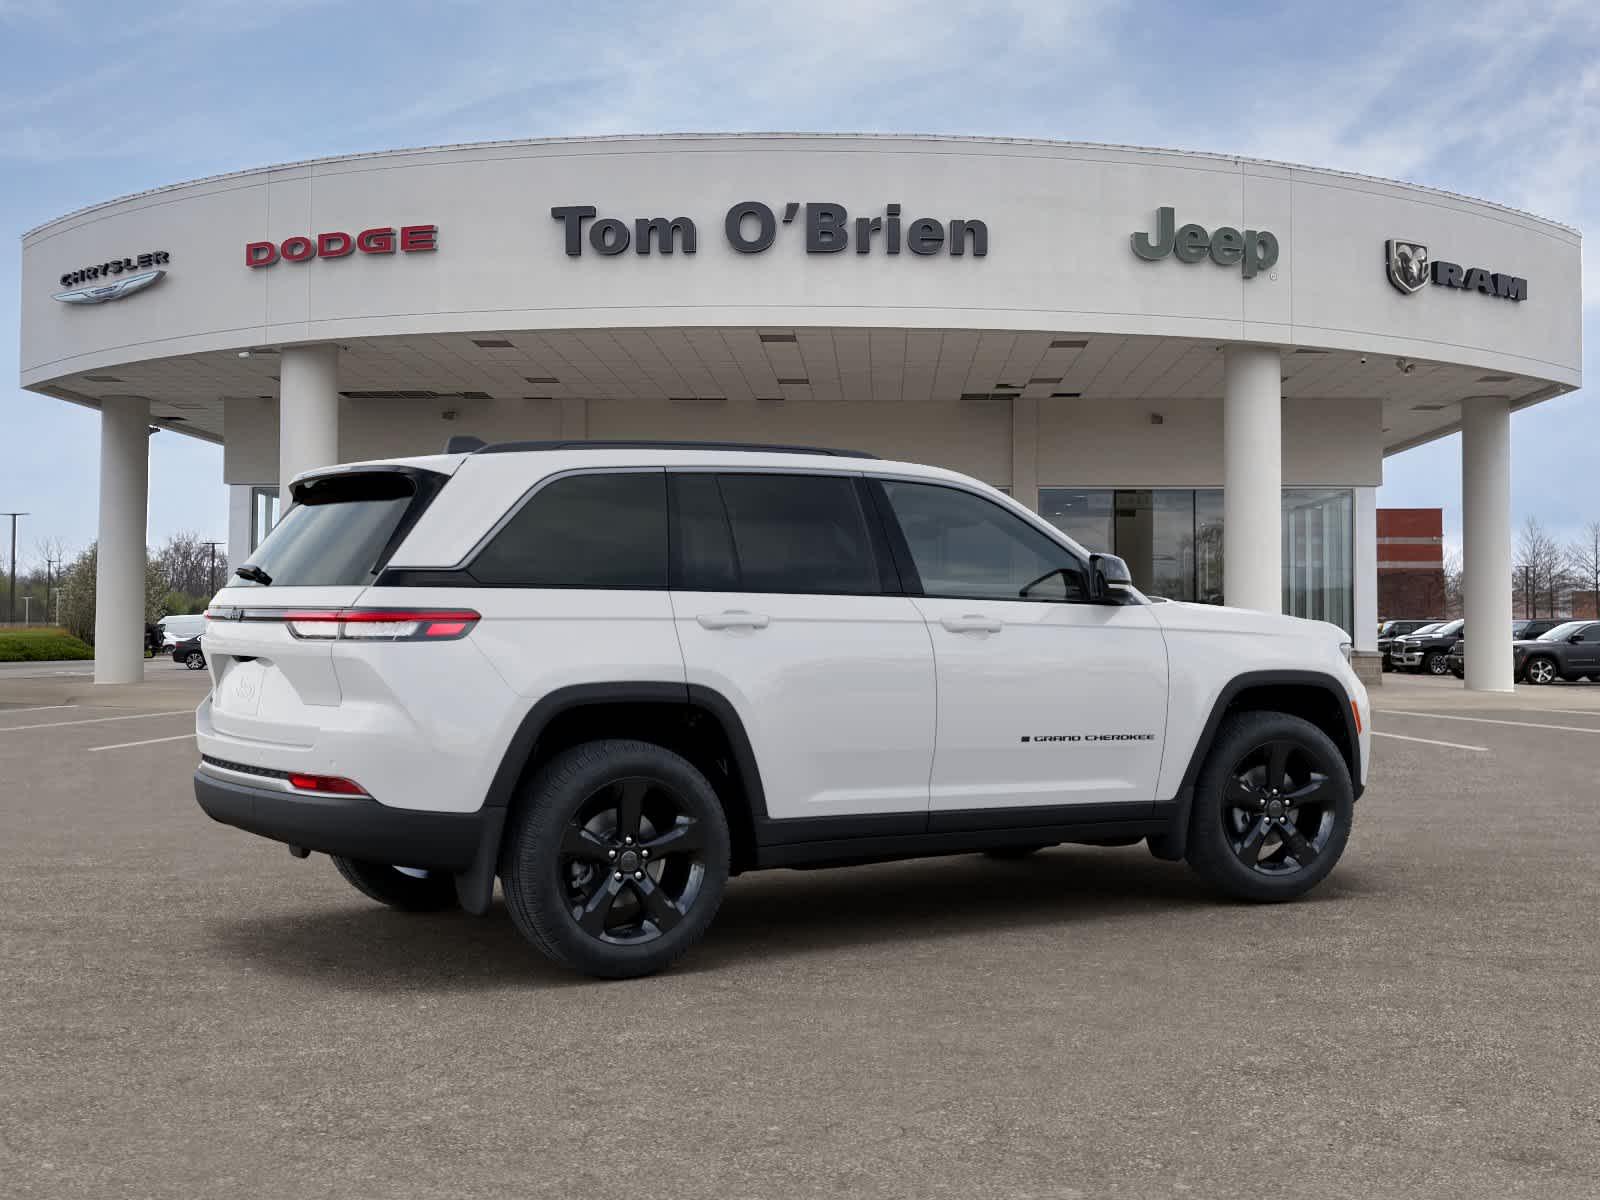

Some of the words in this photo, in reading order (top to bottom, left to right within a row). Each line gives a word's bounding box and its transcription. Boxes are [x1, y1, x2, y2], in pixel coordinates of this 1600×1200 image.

[245, 224, 438, 269] DODGE
[551, 205, 697, 257] Tom
[725, 201, 988, 257] O'Brien
[1130, 206, 1279, 279] Jeep
[60, 249, 170, 287] CHRYSLER
[1430, 260, 1528, 302] RAM
[1034, 735, 1081, 743] GRAND
[1084, 733, 1155, 742] CHEROKEE
